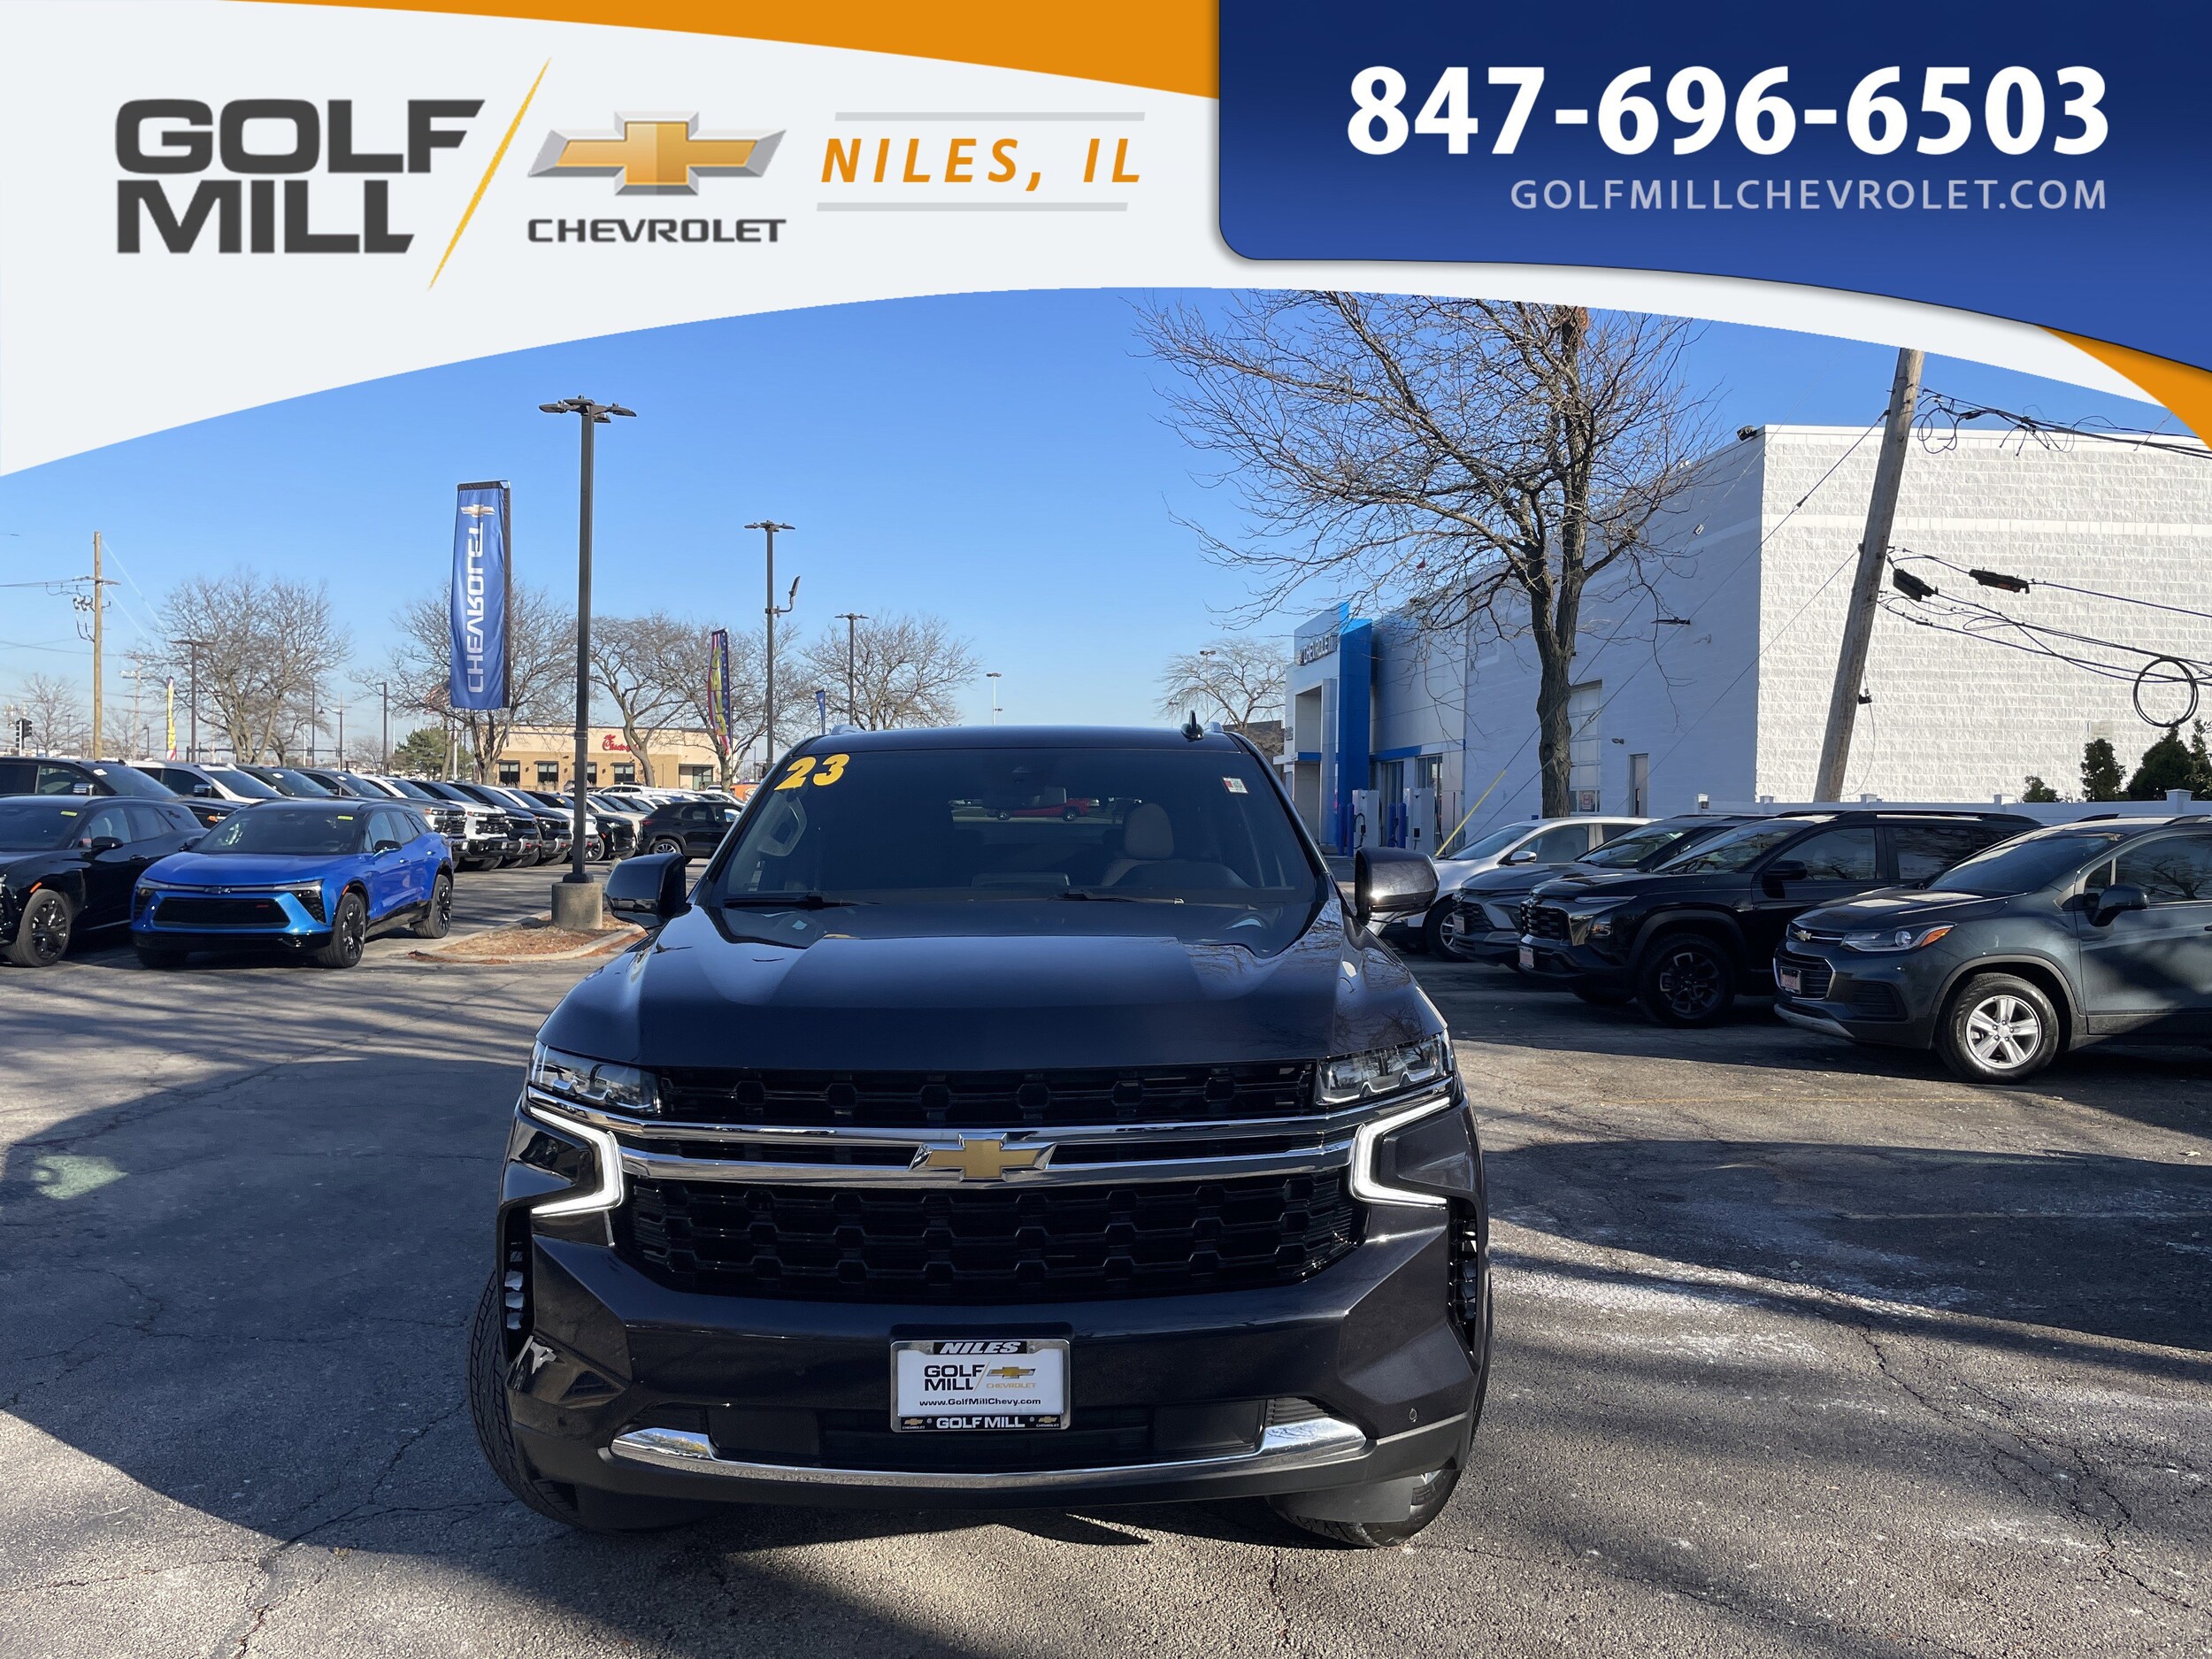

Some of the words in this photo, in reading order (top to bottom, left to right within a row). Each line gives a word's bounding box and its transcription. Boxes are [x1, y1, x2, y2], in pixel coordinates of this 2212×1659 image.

[773, 753, 850, 791] 23
[939, 1341, 1021, 1355] NILES
[924, 1363, 986, 1378] GOLF
[924, 1378, 974, 1392] MILL
[919, 1398, 1041, 1407] www.GolfMillChevy.com
[936, 1417, 982, 1429] GOLF
[984, 1416, 1025, 1428] MILL
